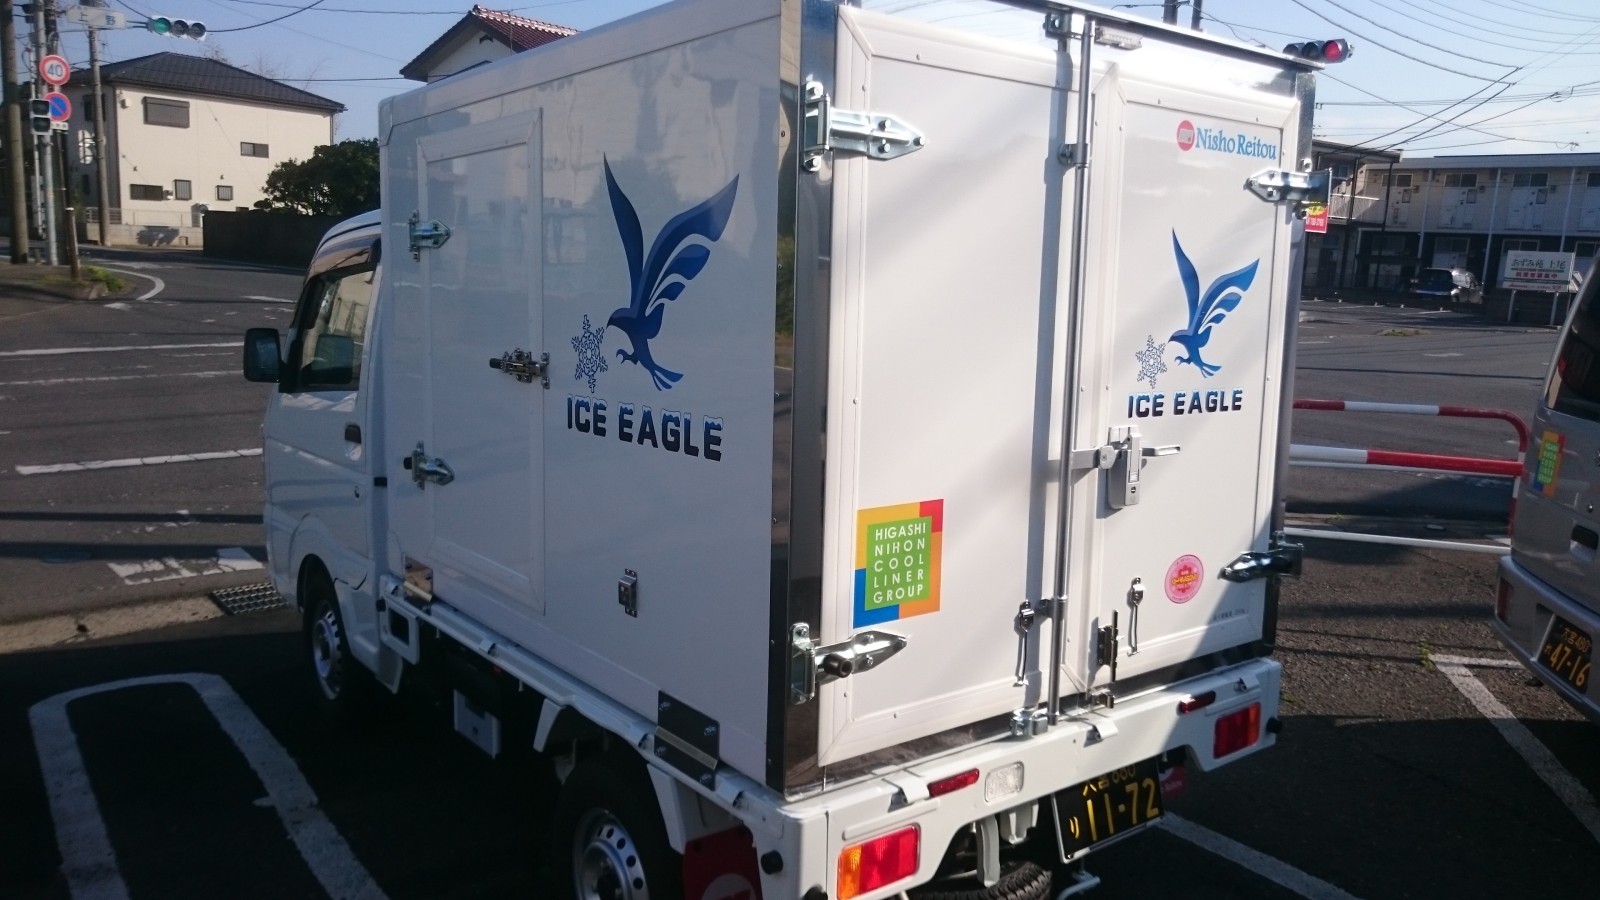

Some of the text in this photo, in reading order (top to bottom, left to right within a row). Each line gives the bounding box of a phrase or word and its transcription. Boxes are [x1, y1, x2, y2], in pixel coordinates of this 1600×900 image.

[47, 63, 64, 77] 40
[1195, 127, 1277, 160] Nisho Reitou
[1127, 387, 1243, 419] ICE EAGLE
[567, 393, 724, 462] ICE EAGLE
[875, 522, 926, 541] HIGASHI
[874, 538, 925, 557] NIHON
[874, 553, 924, 573] COOL
[873, 569, 924, 589] LINER
[873, 584, 923, 604] GROUP
[1086, 777, 1159, 841] 11-72
